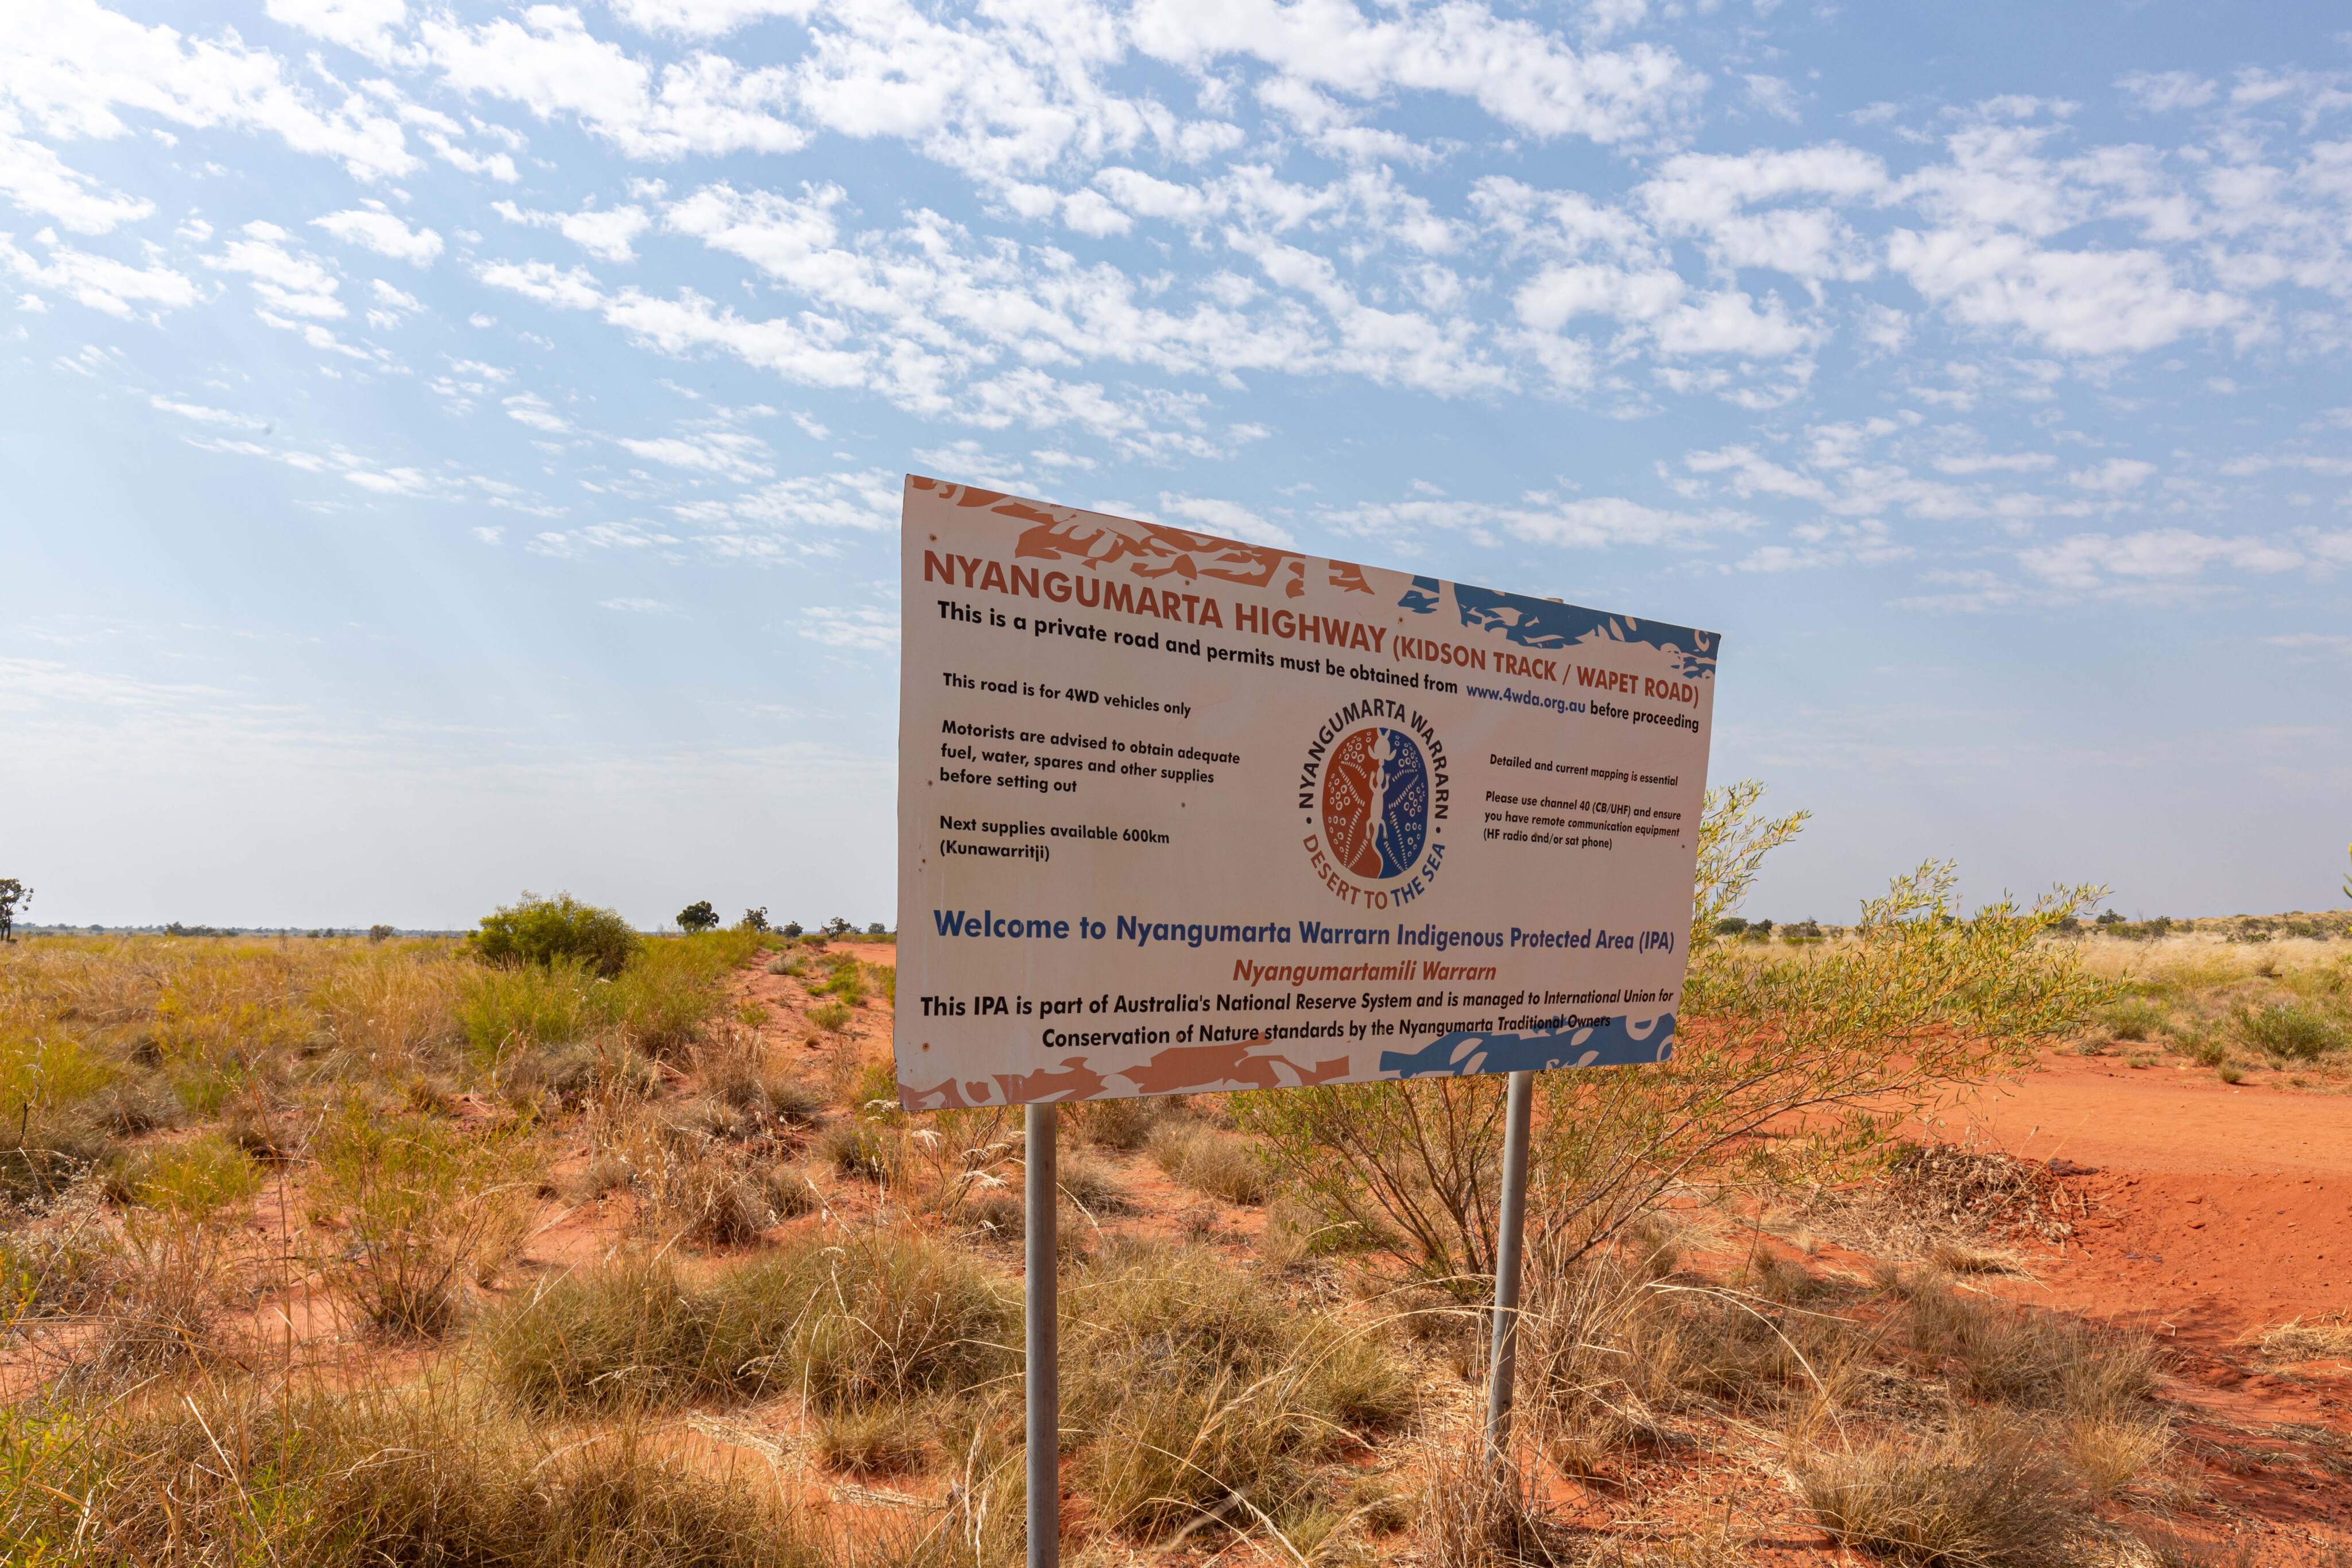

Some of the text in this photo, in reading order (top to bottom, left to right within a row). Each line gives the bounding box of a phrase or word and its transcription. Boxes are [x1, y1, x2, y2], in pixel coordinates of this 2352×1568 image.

[924, 549, 1698, 709] NYANGUMARTA HIGHWAY (KIDSON TRACK / WAPET ROAD)
[938, 601, 1699, 733] This is a private road and permits must be obtained from www.4wda.org.au before proceeding
[943, 673, 1191, 718] This road is for 4WD vehicles only
[942, 720, 1240, 764] Motorists are advised to obtain adequate
[941, 743, 1213, 783] fuel, water, spares and other supplies
[1299, 699, 1449, 819] NYANGUMARTA WARRARN
[1490, 754, 1678, 785] Detailed and current mapping is essential
[941, 767, 1077, 793] before setting out
[1486, 791, 1681, 820] Please use channel 40 (CB/UHF) and ensure
[941, 816, 1169, 843] Next supplies available 600km
[1484, 828, 1612, 850] (HF radio and/or sat phone)
[1485, 811, 1680, 837] you have remote communication equipment
[941, 840, 1049, 862] (Kunawarritji)
[1303, 834, 1445, 909] DESERT TO THE SEA
[934, 910, 1674, 954] Welcome to Nyangumarta Warrarn Indigenous Protected Area (IPA)
[1233, 959, 1496, 986] Nyangumartamili Warrarn
[920, 989, 1673, 1019] This IPA is part of Australia's National Reserve System and is managed to International Union for
[1043, 1015, 1611, 1047] Conservation of Nature standards by the Nyangumarta Traditional Owners
